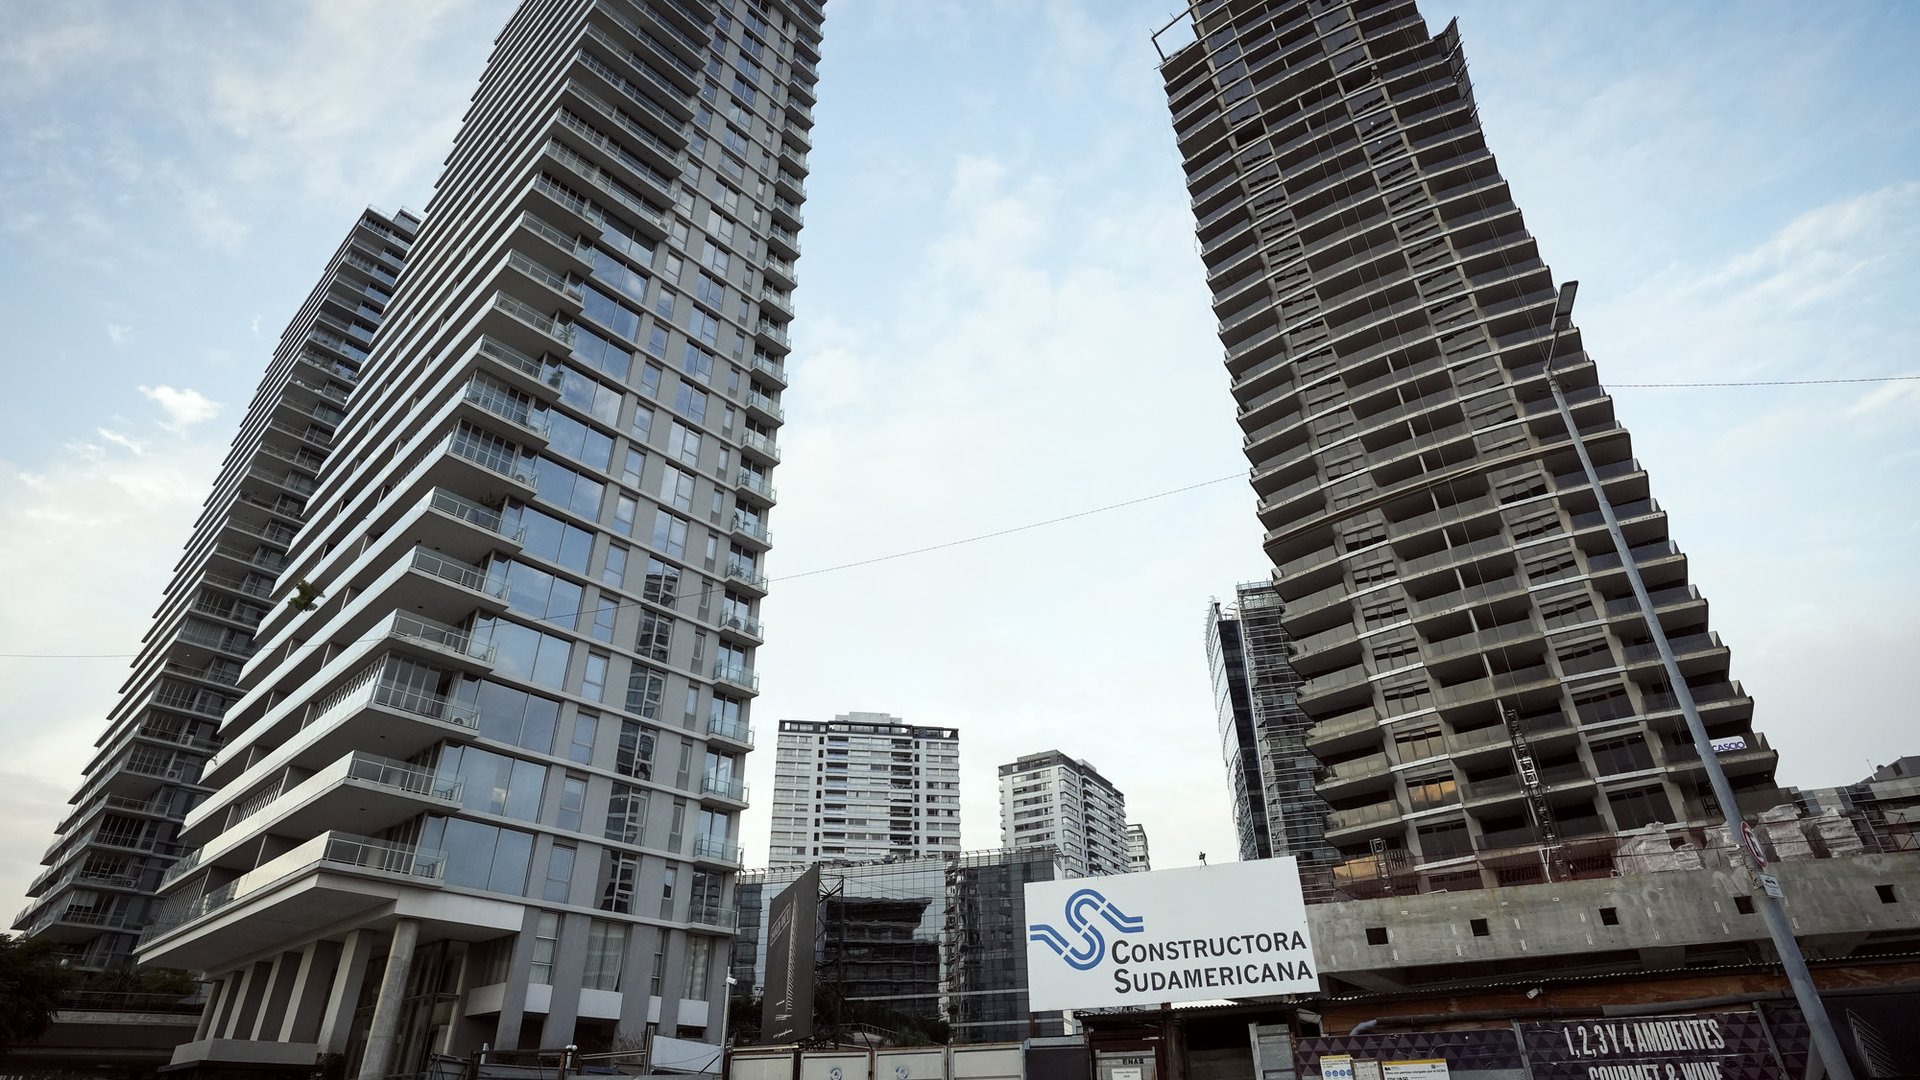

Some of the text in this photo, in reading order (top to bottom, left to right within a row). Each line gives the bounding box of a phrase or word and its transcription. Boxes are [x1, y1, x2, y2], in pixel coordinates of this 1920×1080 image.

[1111, 930, 1307, 965] CONSTRUCTORA
[1114, 960, 1314, 994] SUDAMERICANA
[1604, 1023, 1621, 1053] Y
[1622, 1023, 1635, 1053] 4
[1633, 1018, 1726, 1053] AMBIENTES
